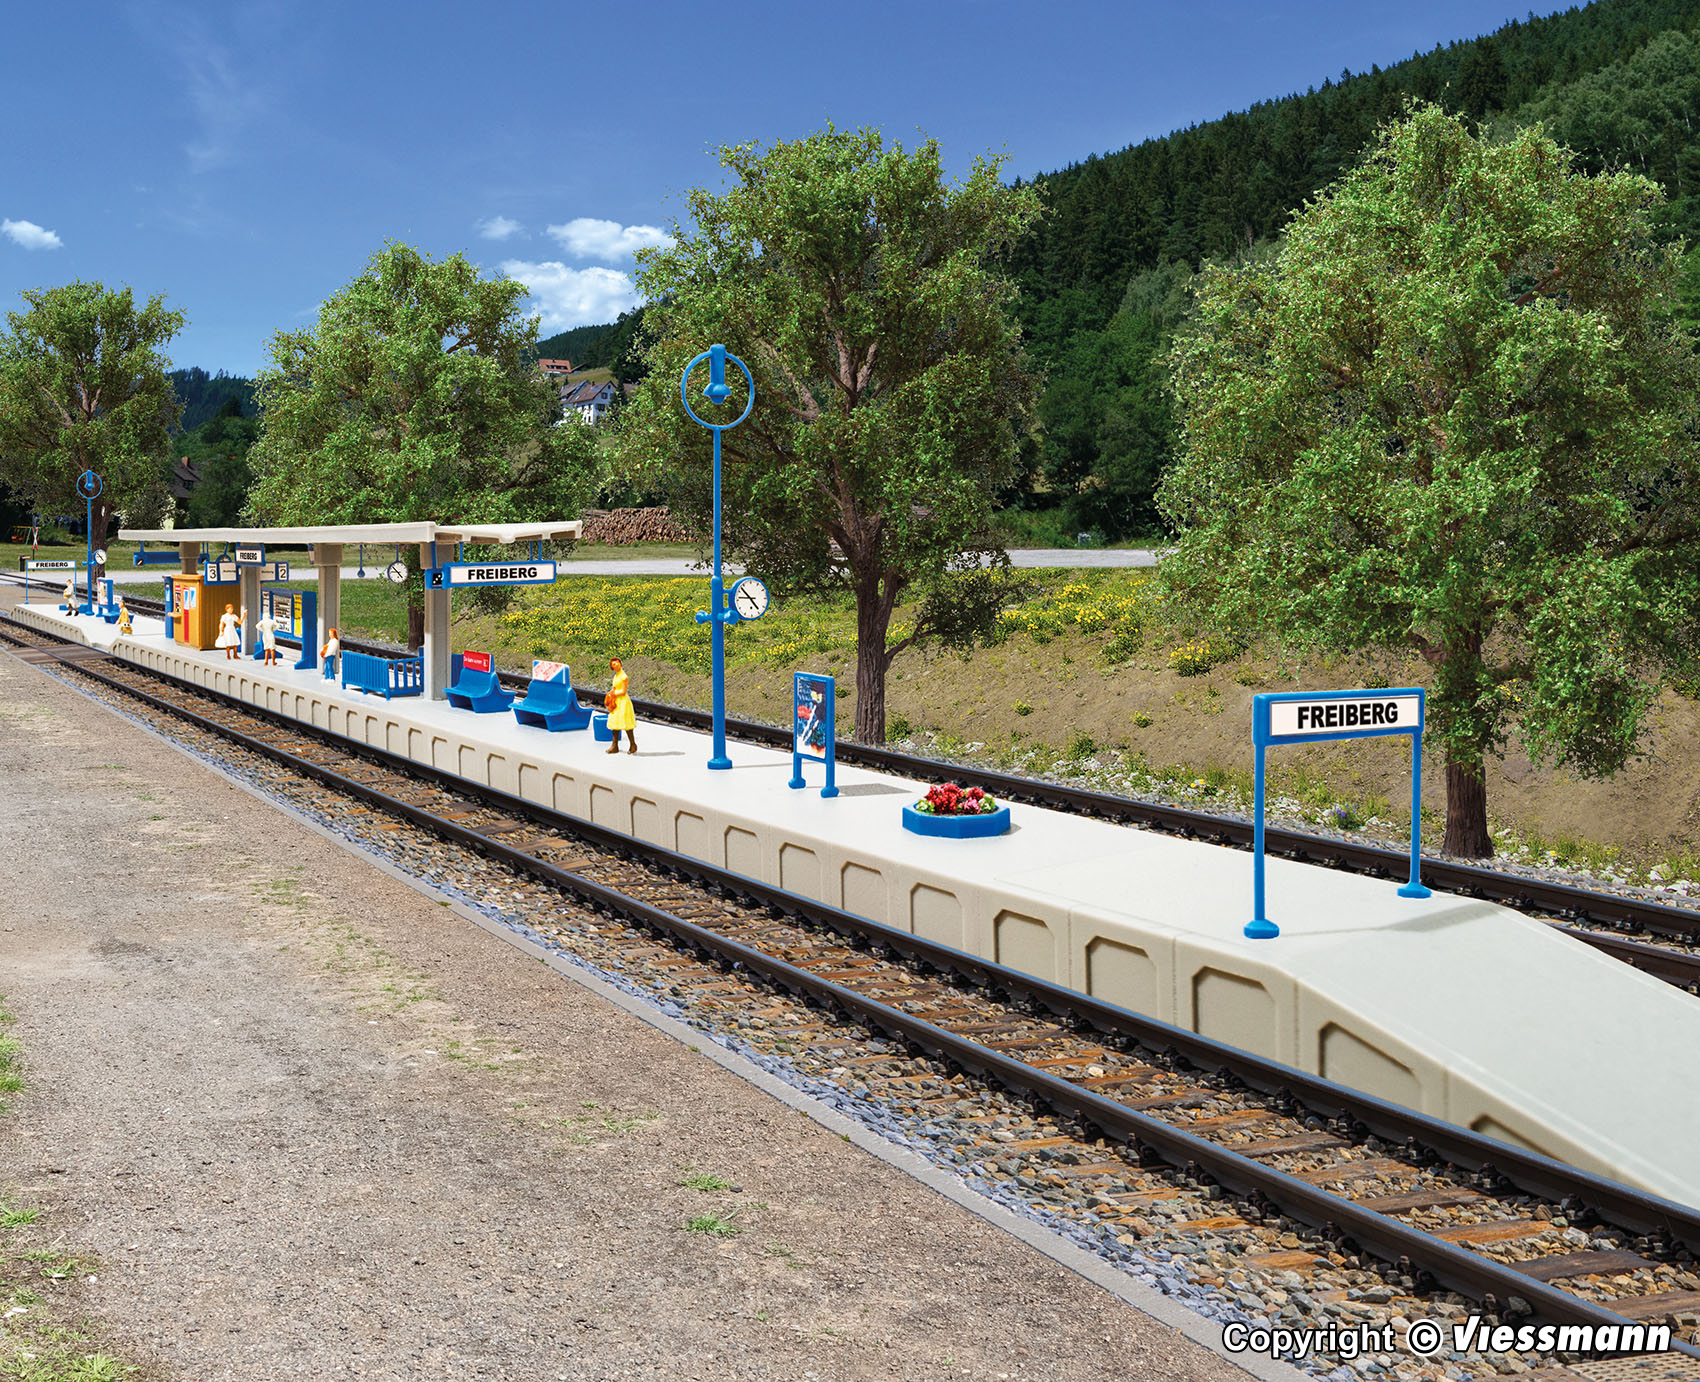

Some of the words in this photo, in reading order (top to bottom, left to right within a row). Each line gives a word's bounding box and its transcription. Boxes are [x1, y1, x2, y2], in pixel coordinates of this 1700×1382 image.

[240, 552, 257, 560] FREIBERG
[209, 569, 217, 579] 3
[279, 568, 287, 579] 2
[467, 567, 538, 580] FREIBERG
[1297, 702, 1398, 729] FREIBERG
